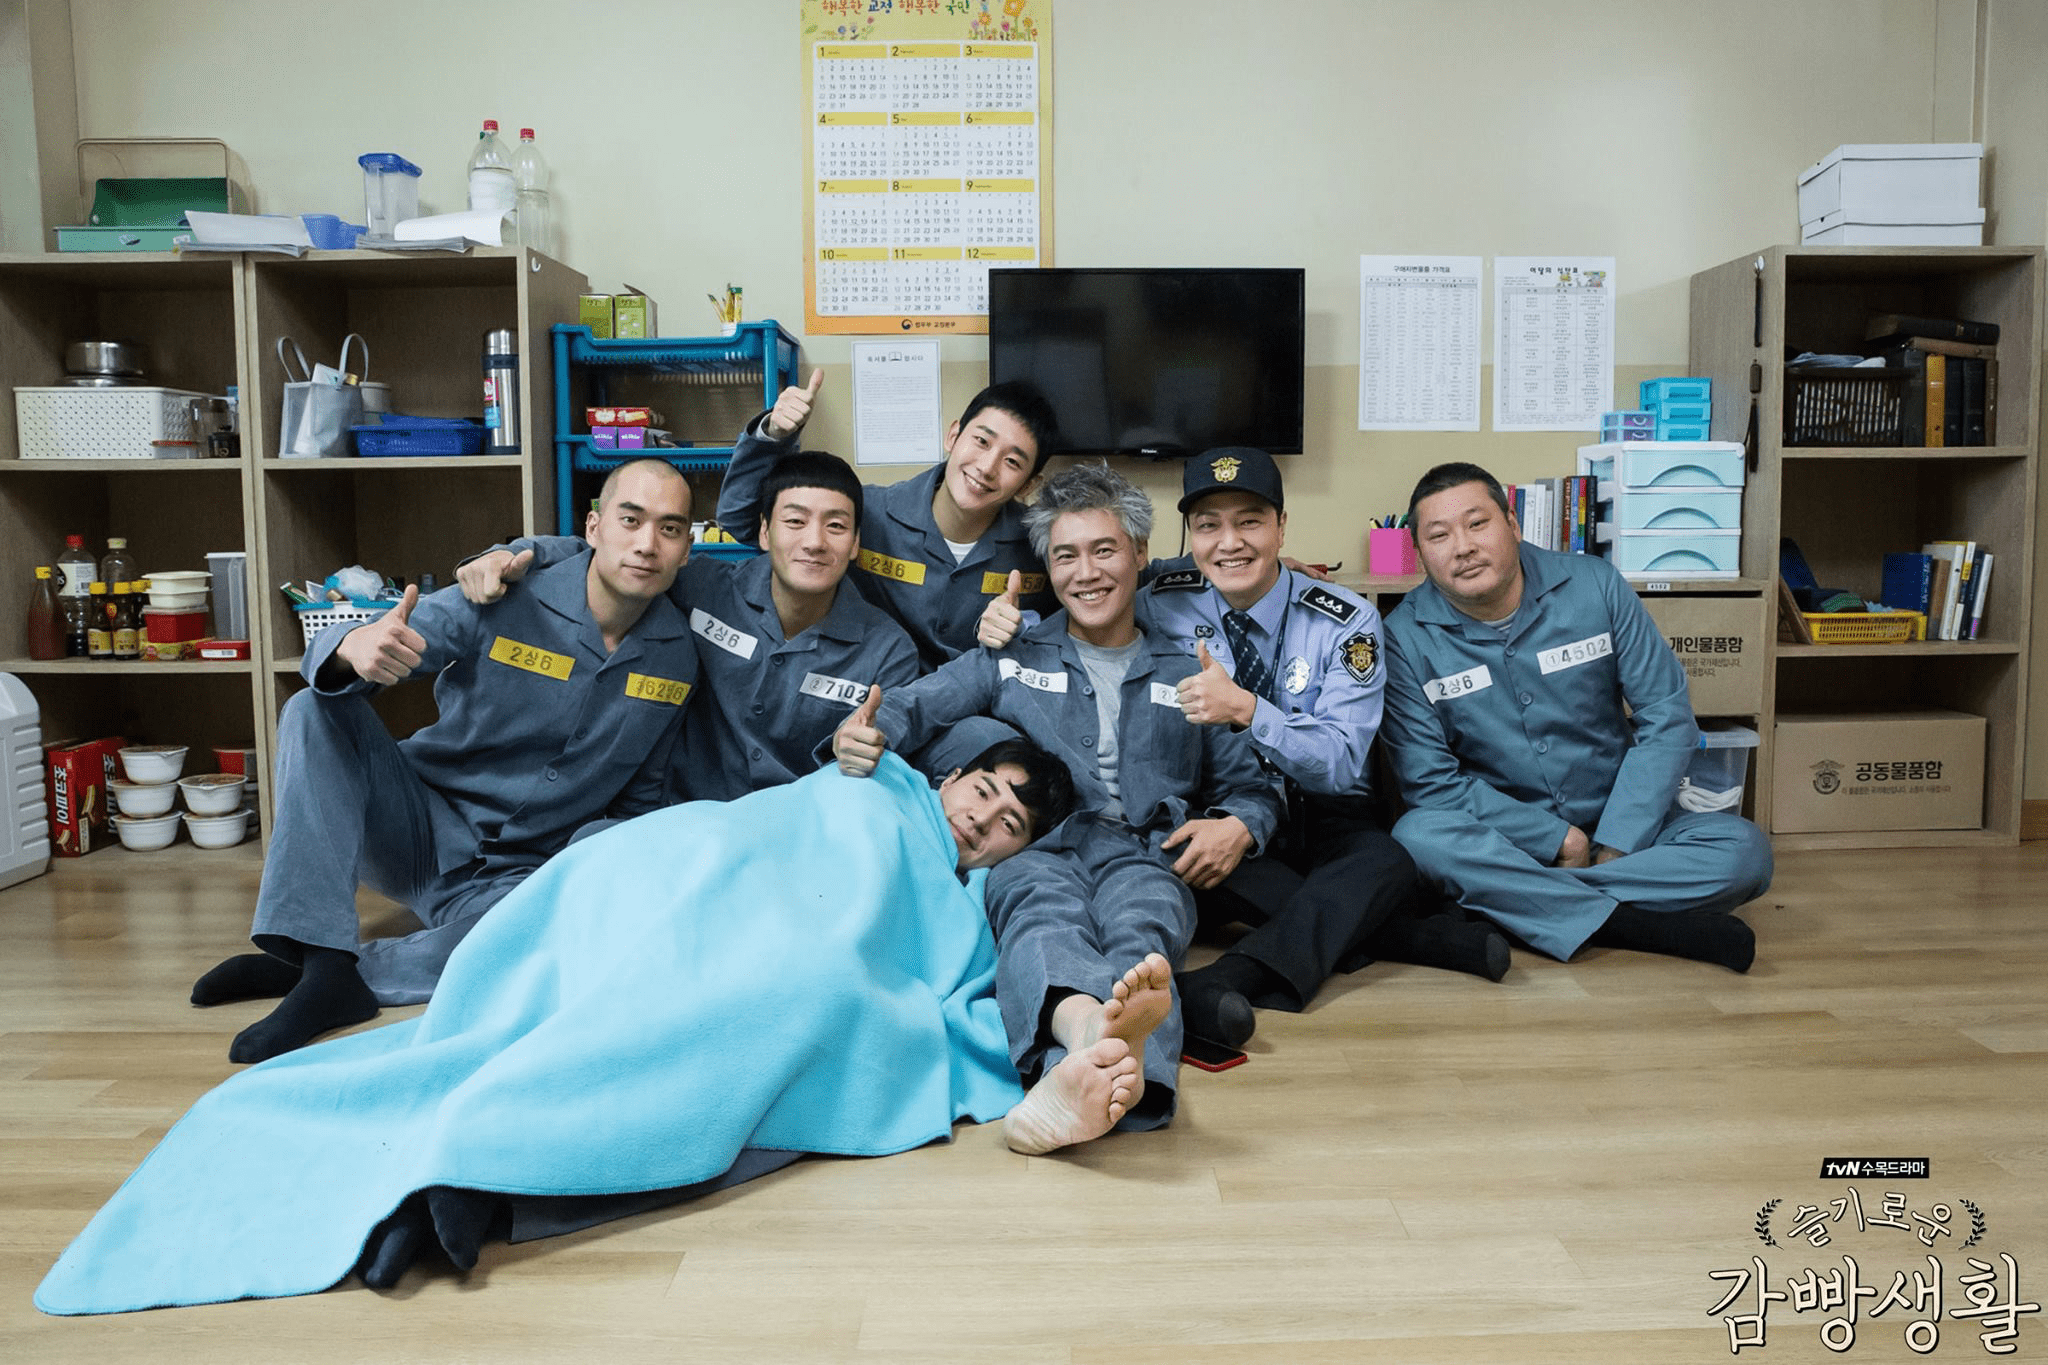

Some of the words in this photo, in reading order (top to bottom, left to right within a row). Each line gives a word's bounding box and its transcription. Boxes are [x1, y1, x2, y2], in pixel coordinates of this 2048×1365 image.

[823, 0, 862, 16] 행복한
[868, 0, 892, 14] 교정
[899, 0, 940, 15] 행복한
[820, 47, 824, 57] 1
[891, 46, 899, 56] 2
[966, 45, 972, 56] 3
[819, 114, 826, 124] 4
[893, 114, 900, 124] 5
[966, 113, 973, 124] 6
[820, 182, 827, 192] 7
[893, 181, 899, 191] 8
[966, 180, 973, 190] 9
[822, 249, 834, 260] 10
[895, 249, 905, 259] 11
[968, 248, 979, 259] 12
[870, 557, 905, 578] 2상6
[704, 619, 740, 648] 2상6
[1669, 636, 1743, 653] 개인물품함
[508, 646, 553, 671] 2상6
[1015, 666, 1049, 688] 2상6
[1438, 675, 1473, 696] 2상6
[1856, 761, 1944, 781] 공동물품함
[54, 765, 70, 825] 초코파이
